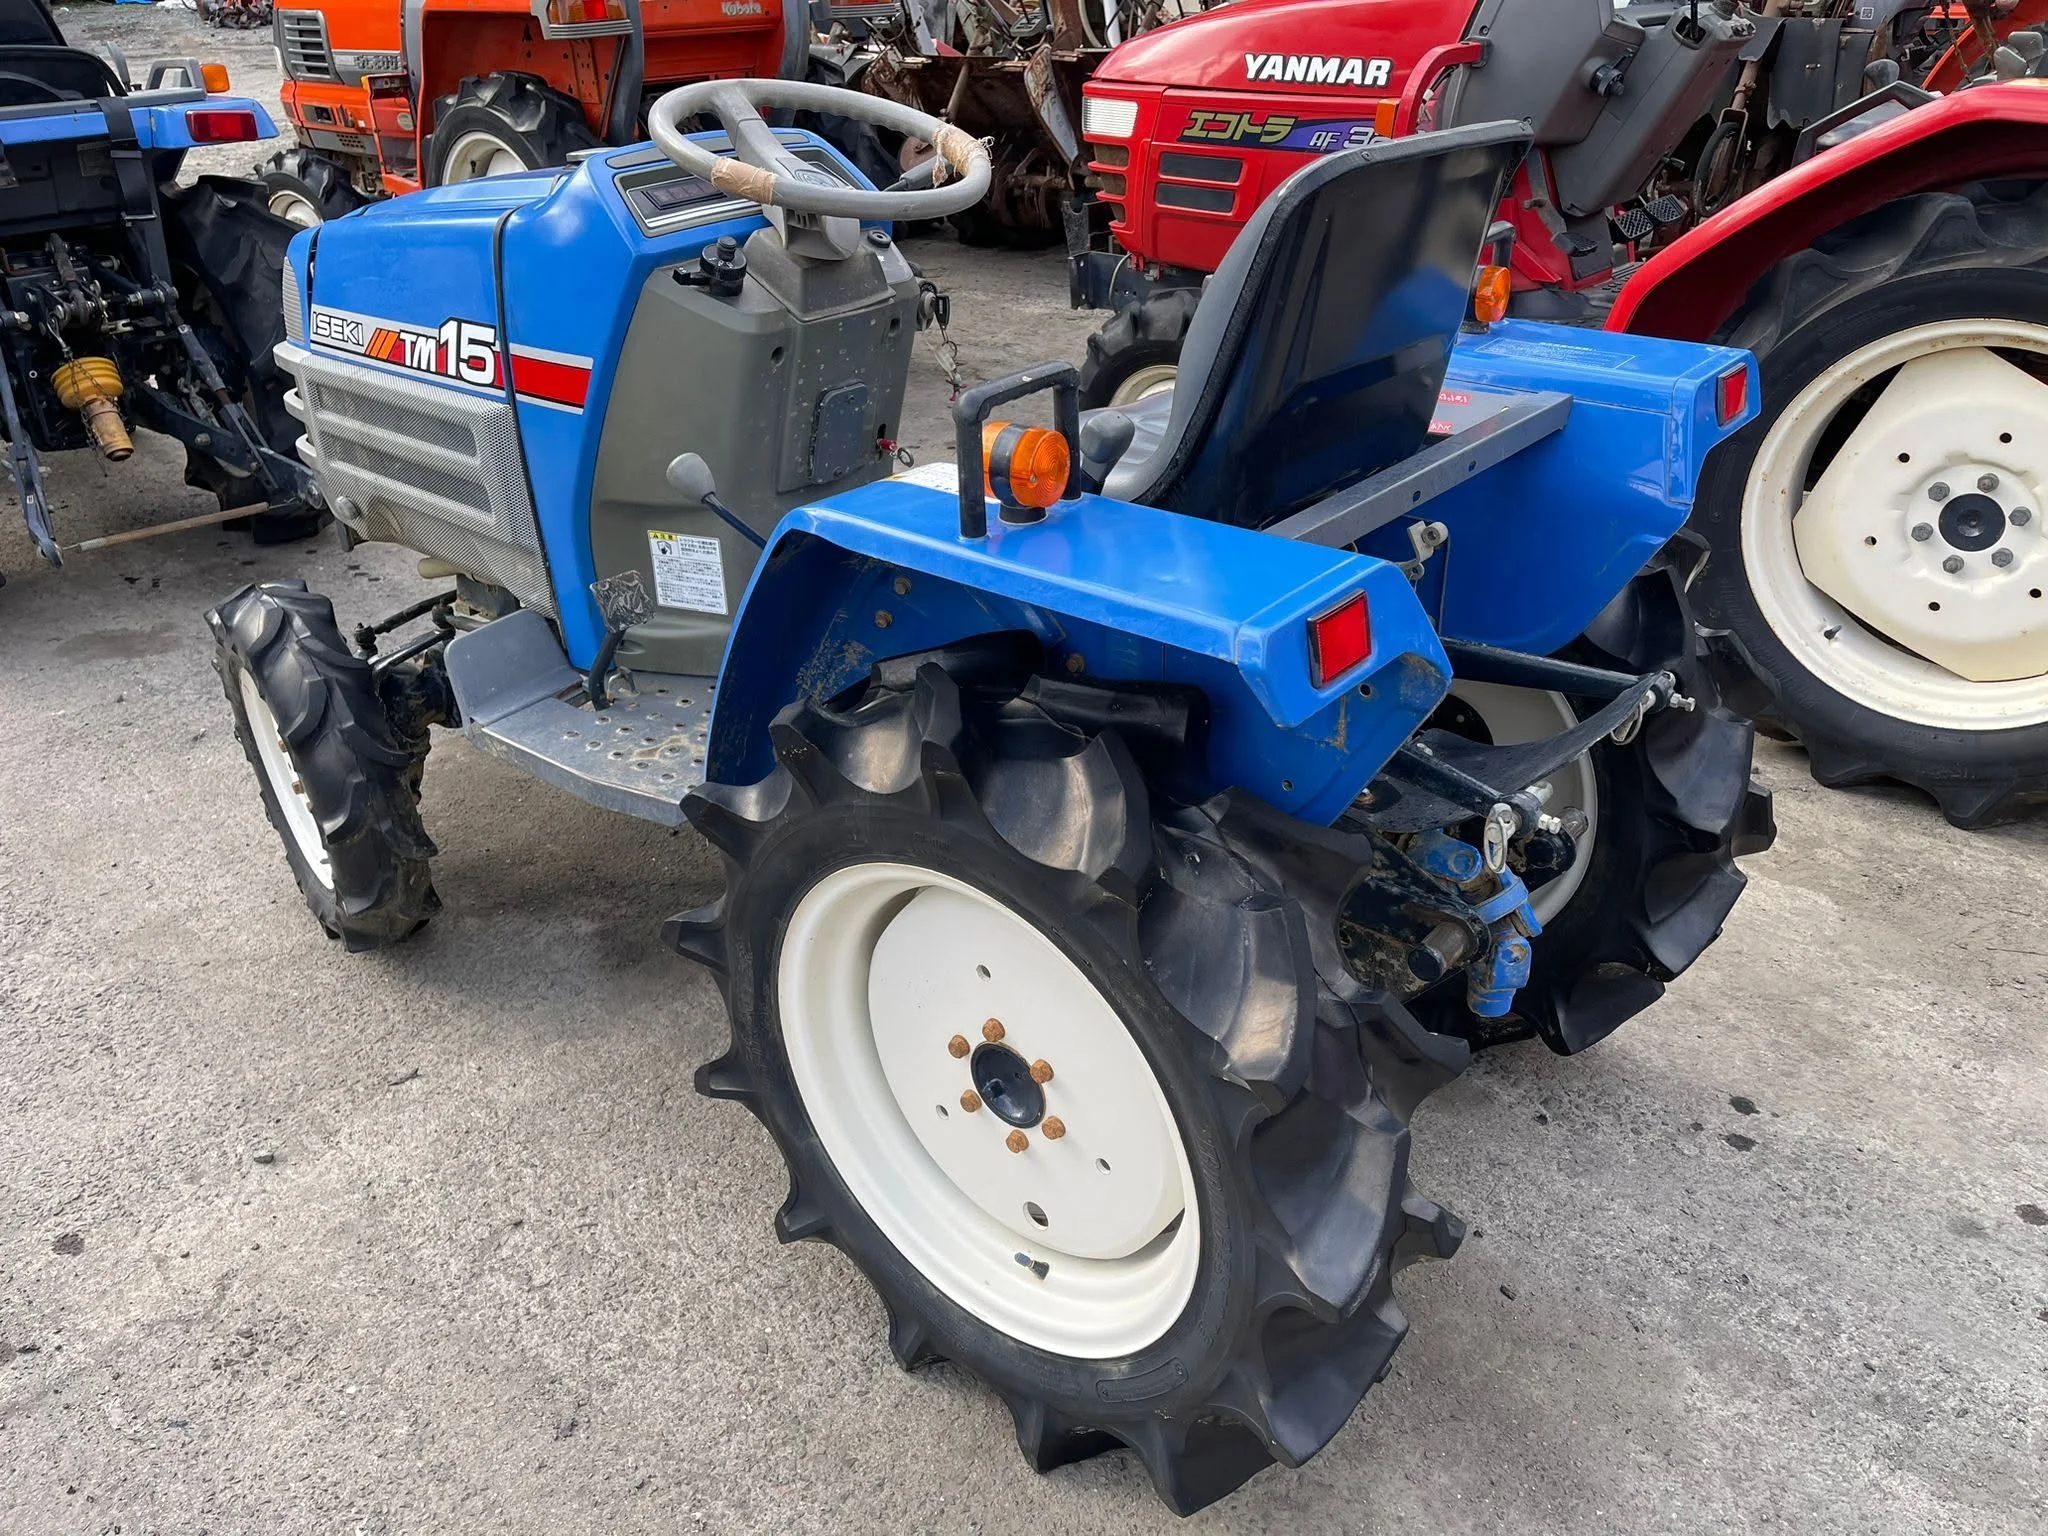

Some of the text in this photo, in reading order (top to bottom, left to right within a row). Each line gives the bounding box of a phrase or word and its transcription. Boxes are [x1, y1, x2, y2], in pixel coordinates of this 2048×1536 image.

[721, 1, 762, 16] Kubota
[1244, 53, 1392, 87] YANMAR
[1181, 110, 1297, 144] エコトラ
[1308, 130, 1342, 151] AF
[312, 311, 497, 386] ISEKI TM15
